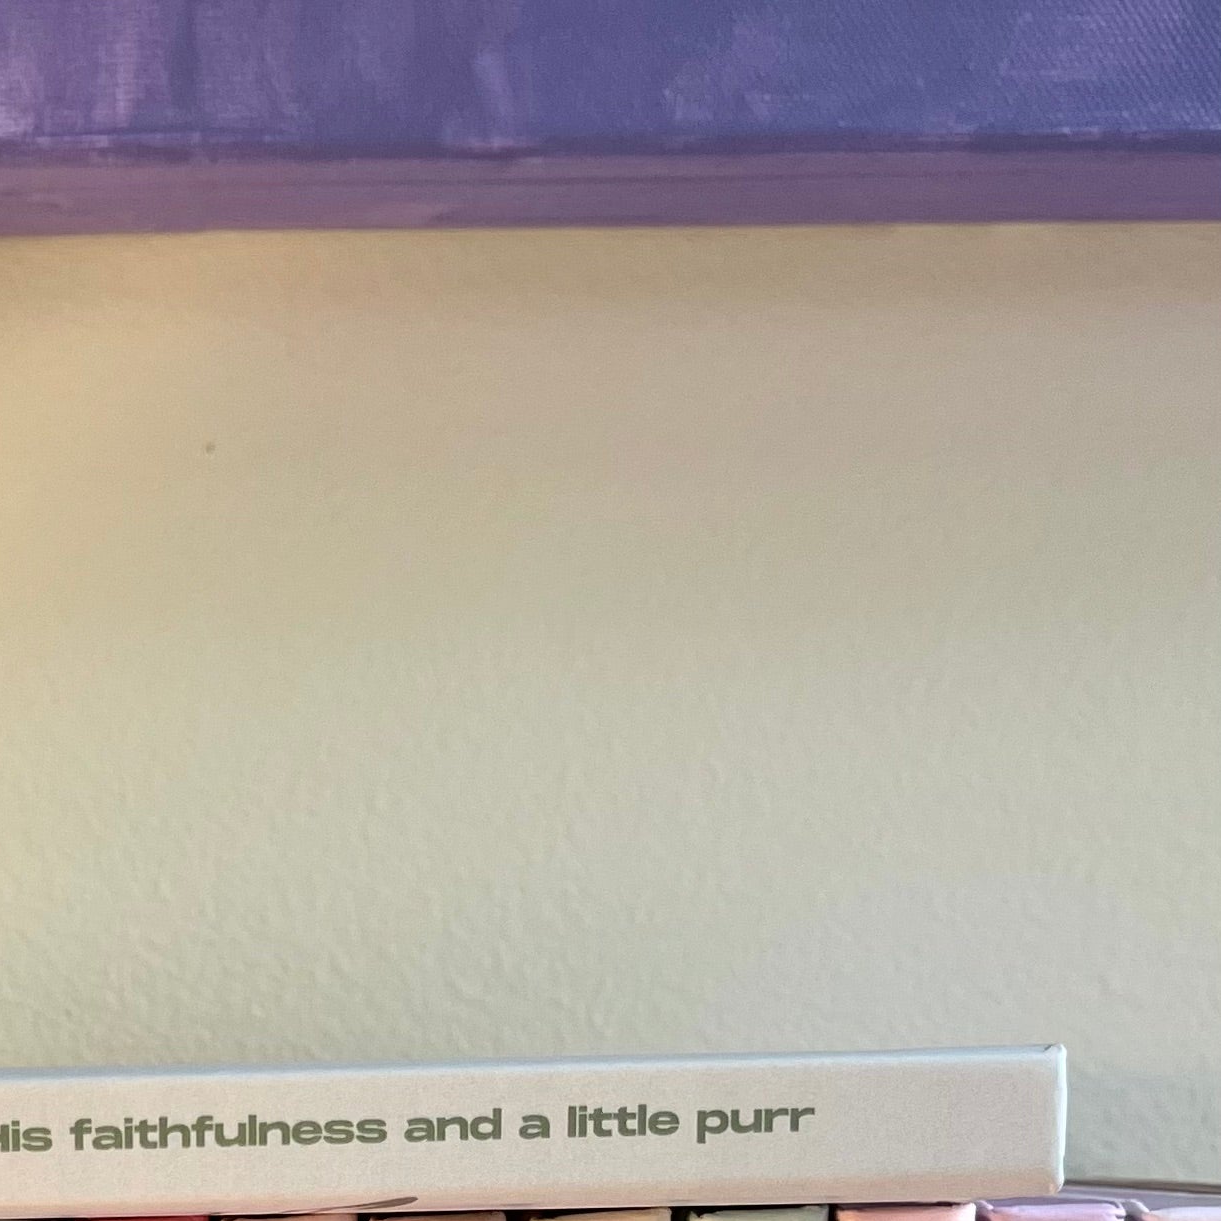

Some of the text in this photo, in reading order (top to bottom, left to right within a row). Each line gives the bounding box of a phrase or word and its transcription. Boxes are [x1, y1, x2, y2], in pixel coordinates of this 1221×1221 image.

[70, 1115, 387, 1150] faithfulness
[404, 1108, 502, 1142] and
[519, 1115, 550, 1139] a
[568, 1104, 680, 1137] little
[697, 1107, 815, 1144] purr
